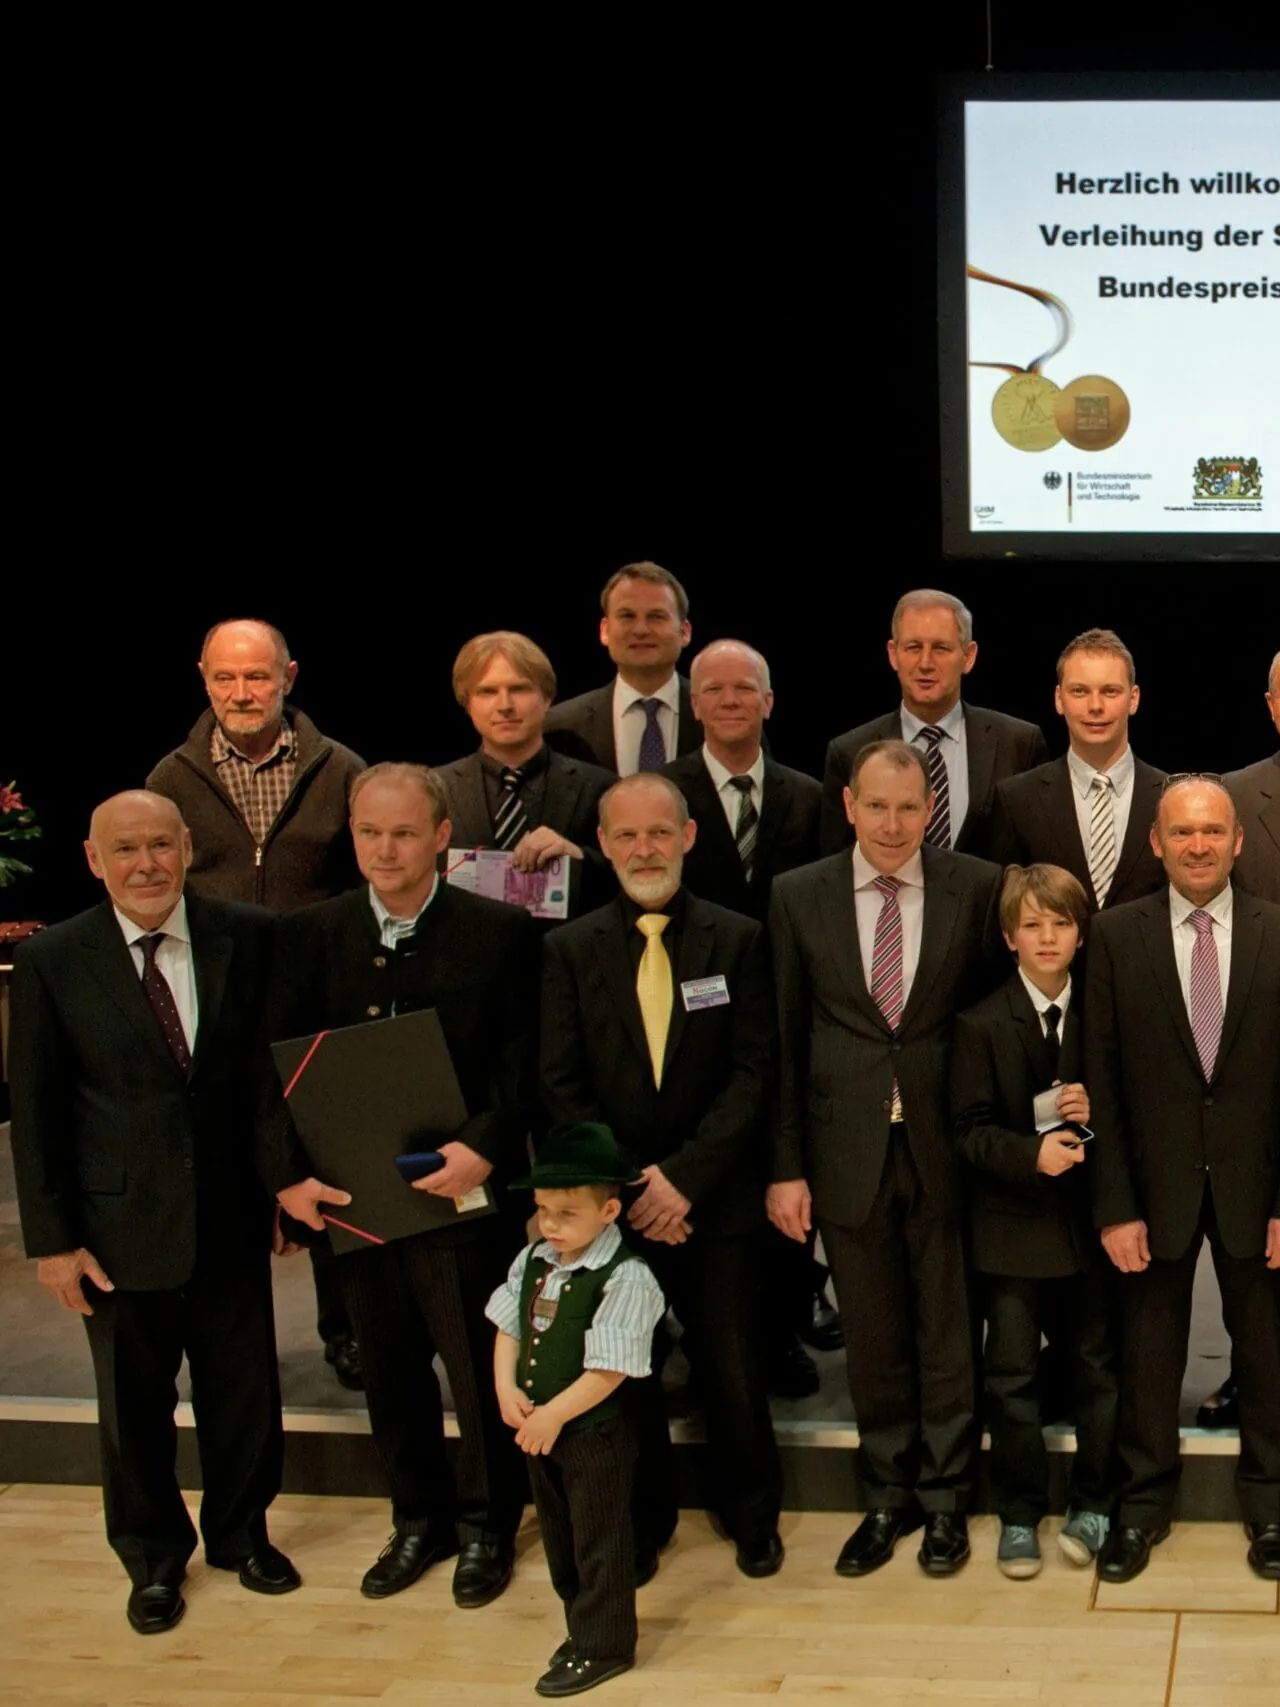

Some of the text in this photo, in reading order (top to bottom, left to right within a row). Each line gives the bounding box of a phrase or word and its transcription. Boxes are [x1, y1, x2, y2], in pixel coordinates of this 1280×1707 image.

[1055, 171, 1180, 195] Herzlich
[1038, 223, 1203, 253] Verleihung
[1213, 223, 1264, 248] der
[1076, 471, 1153, 481] Bundesministerium
[1076, 481, 1132, 491] für Wirtschaft
[1076, 491, 1141, 503] und Technologie
